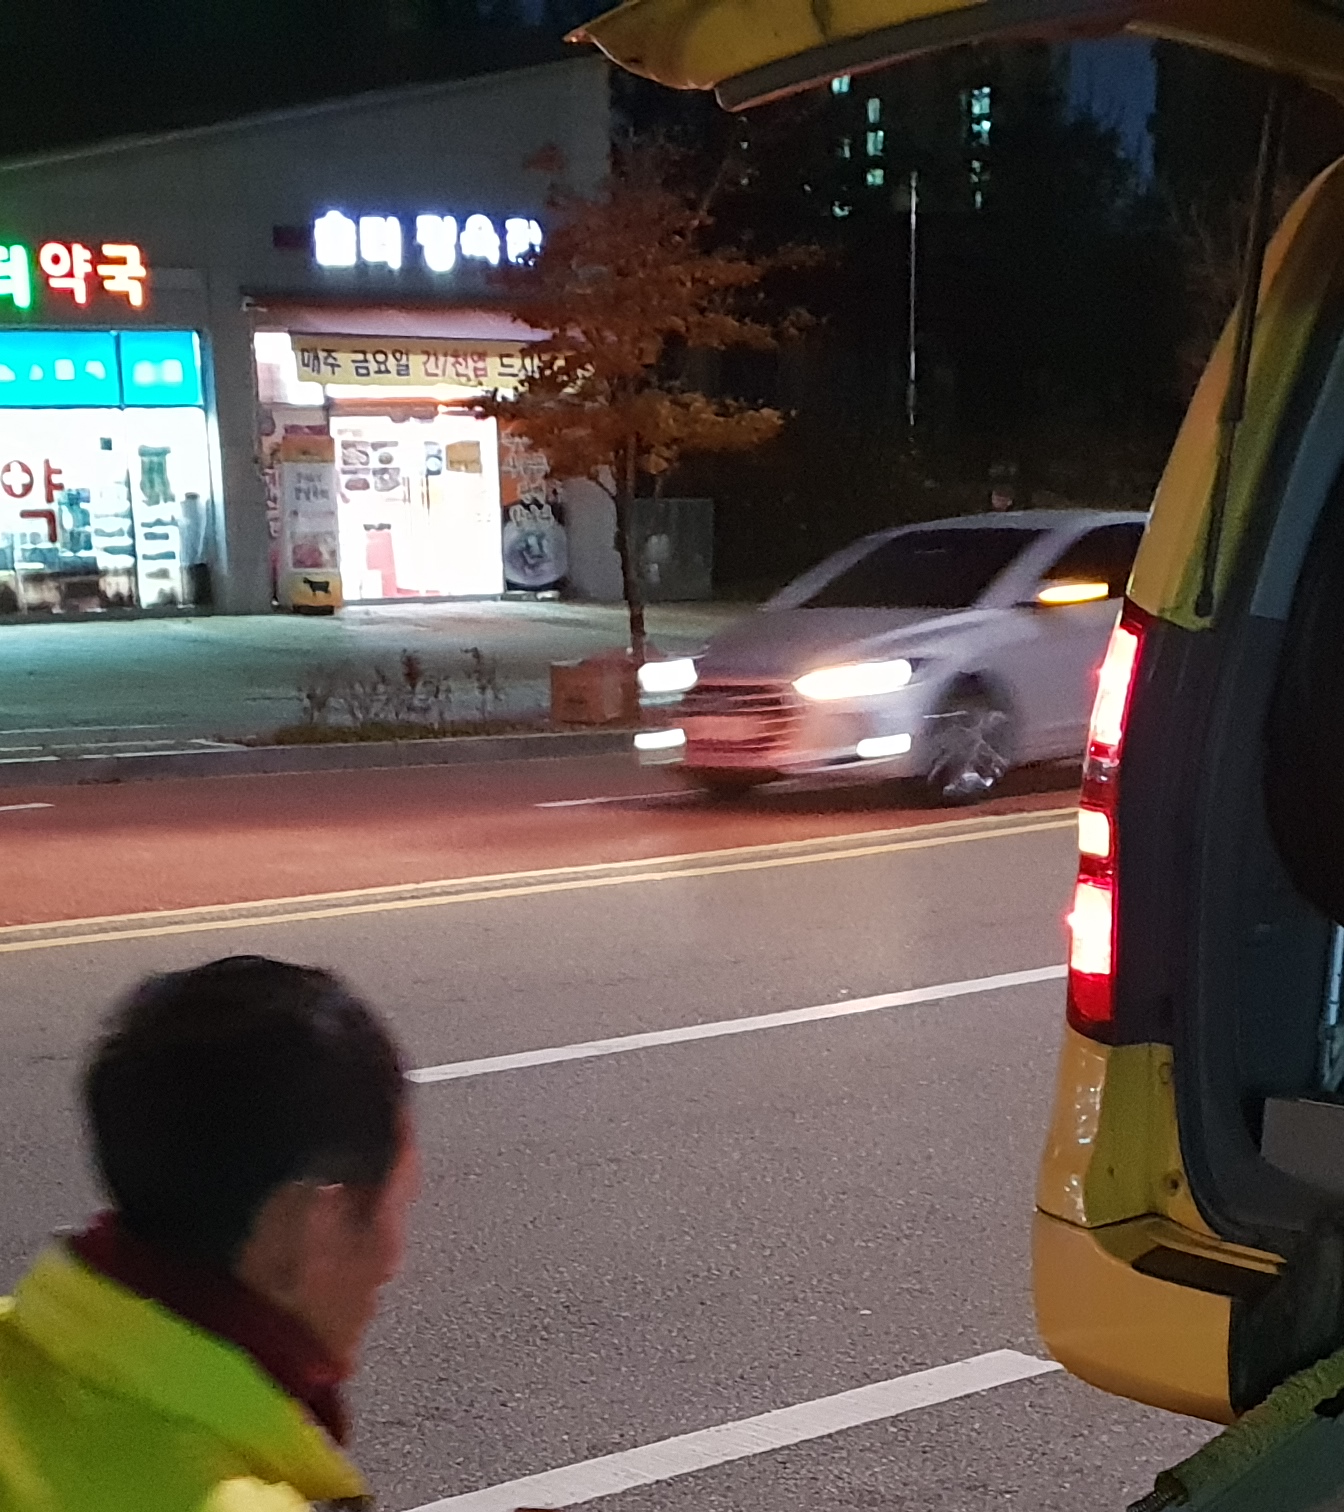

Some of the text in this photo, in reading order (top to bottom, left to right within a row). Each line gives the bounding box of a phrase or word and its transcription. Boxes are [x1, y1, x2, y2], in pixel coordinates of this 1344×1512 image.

[39, 241, 147, 308] 약국
[300, 347, 342, 376] 매주
[350, 348, 411, 378] 금요일
